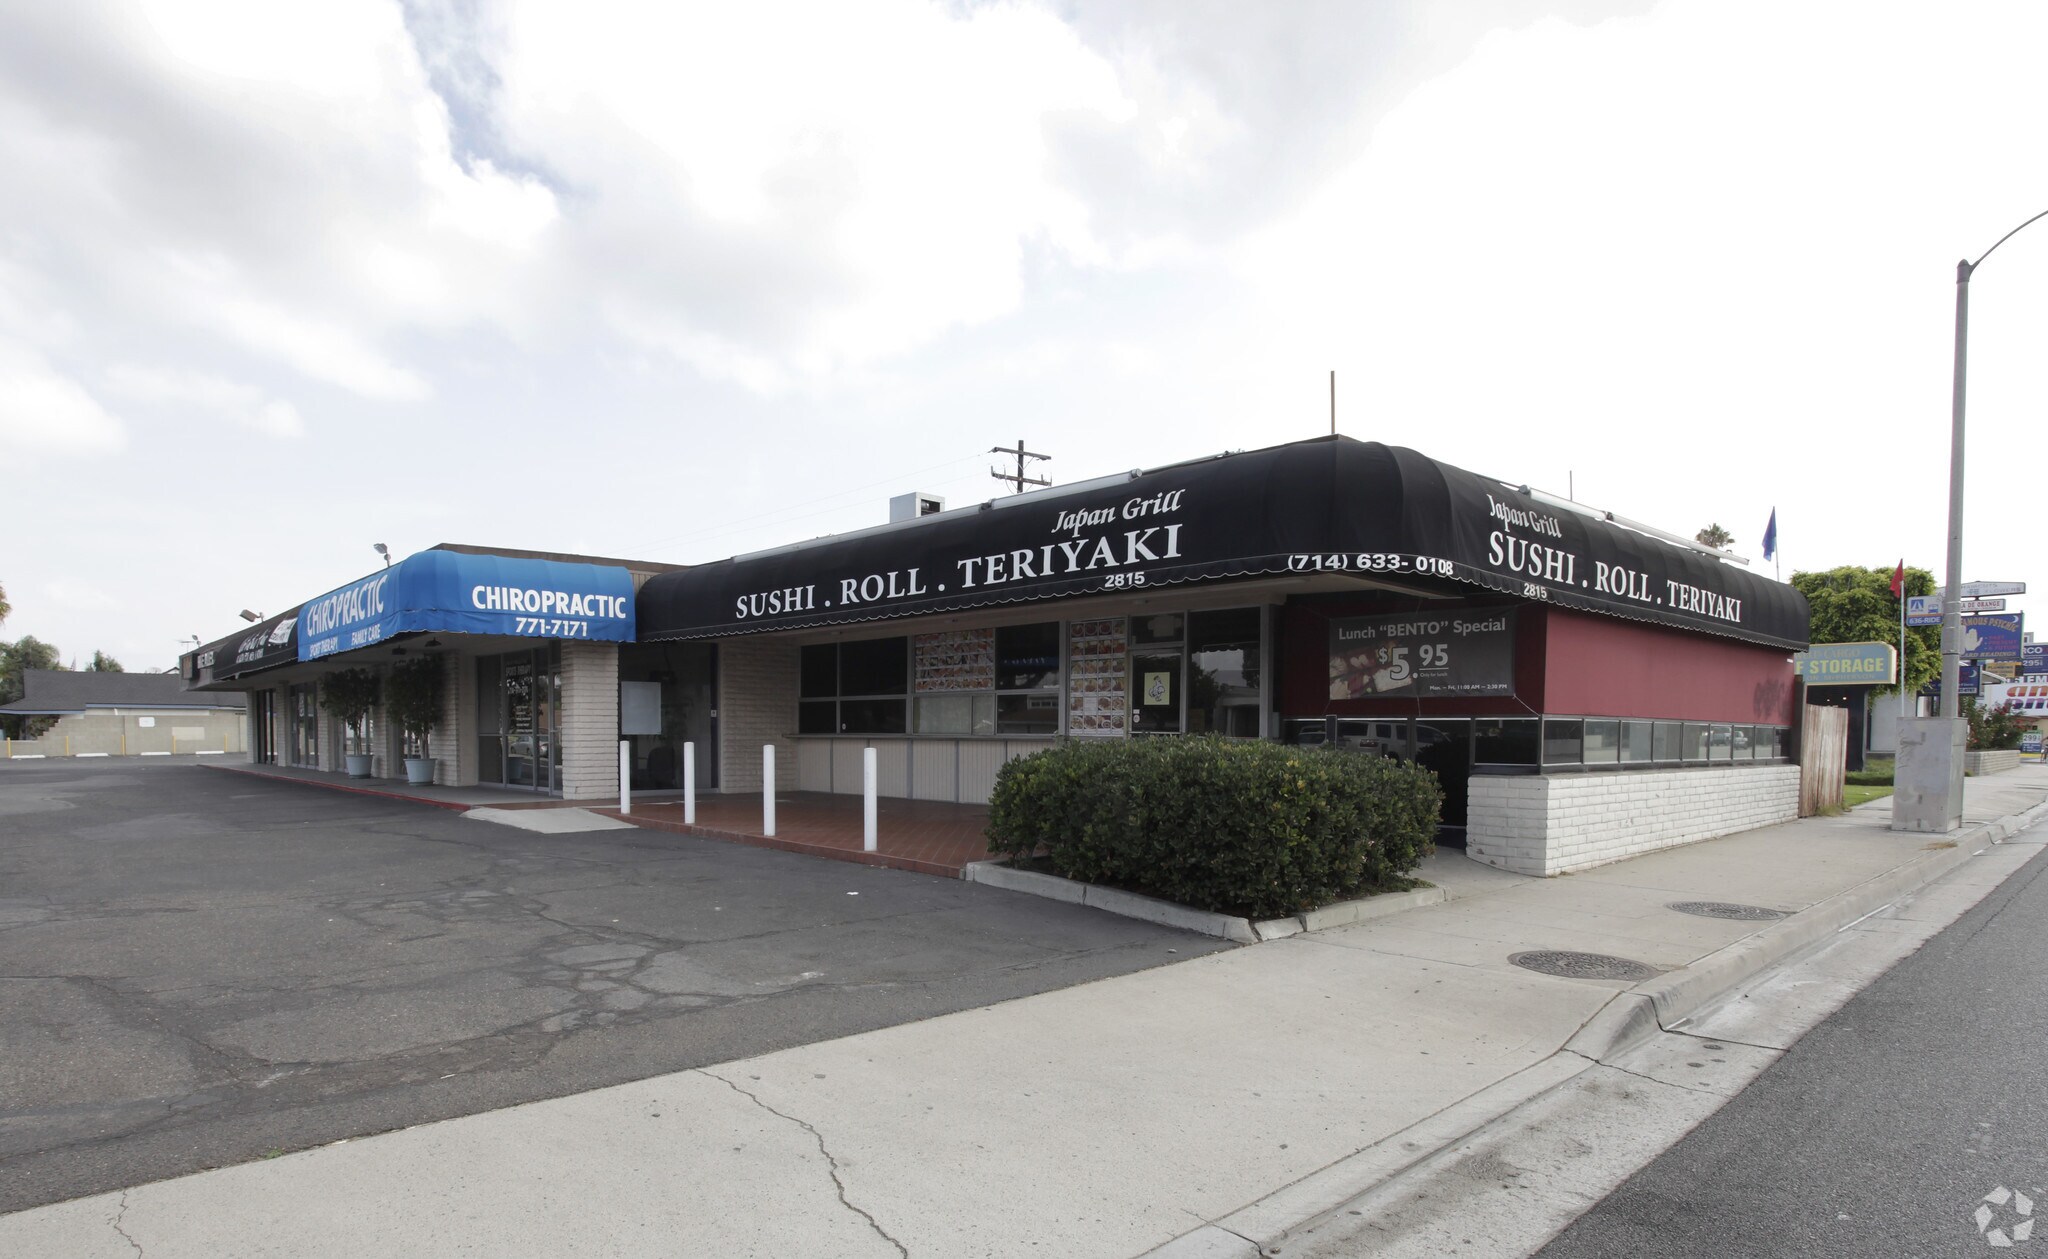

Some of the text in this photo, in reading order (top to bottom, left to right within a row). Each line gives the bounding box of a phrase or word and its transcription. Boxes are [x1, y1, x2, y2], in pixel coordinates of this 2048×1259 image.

[1051, 488, 1185, 538] Japan Grill
[1486, 493, 1562, 538] Japan Grill
[735, 585, 815, 619] SUSHI
[840, 567, 927, 605] ROLL
[957, 523, 1183, 588] TERIYAKI
[1287, 554, 1348, 570] (714)
[1415, 556, 1454, 575] 0108
[1105, 571, 1145, 588] 2815
[1489, 531, 1575, 585] SUSHI
[1595, 561, 1652, 602] ROLL
[1667, 579, 1741, 623] TERIYAKI
[472, 585, 626, 618] CHIROPRACTIC
[1524, 582, 1547, 599] 2815
[307, 575, 388, 637] CHIROPRACTIC
[515, 617, 588, 637] 771-7171
[1338, 626, 1376, 640] Lunch
[1453, 617, 1506, 636] Special
[1909, 616, 1940, 624] 636-RIDE
[352, 624, 380, 646] FAMILY CARE
[2022, 646, 2043, 655] RCO
[1809, 658, 1884, 674] STORAGE
